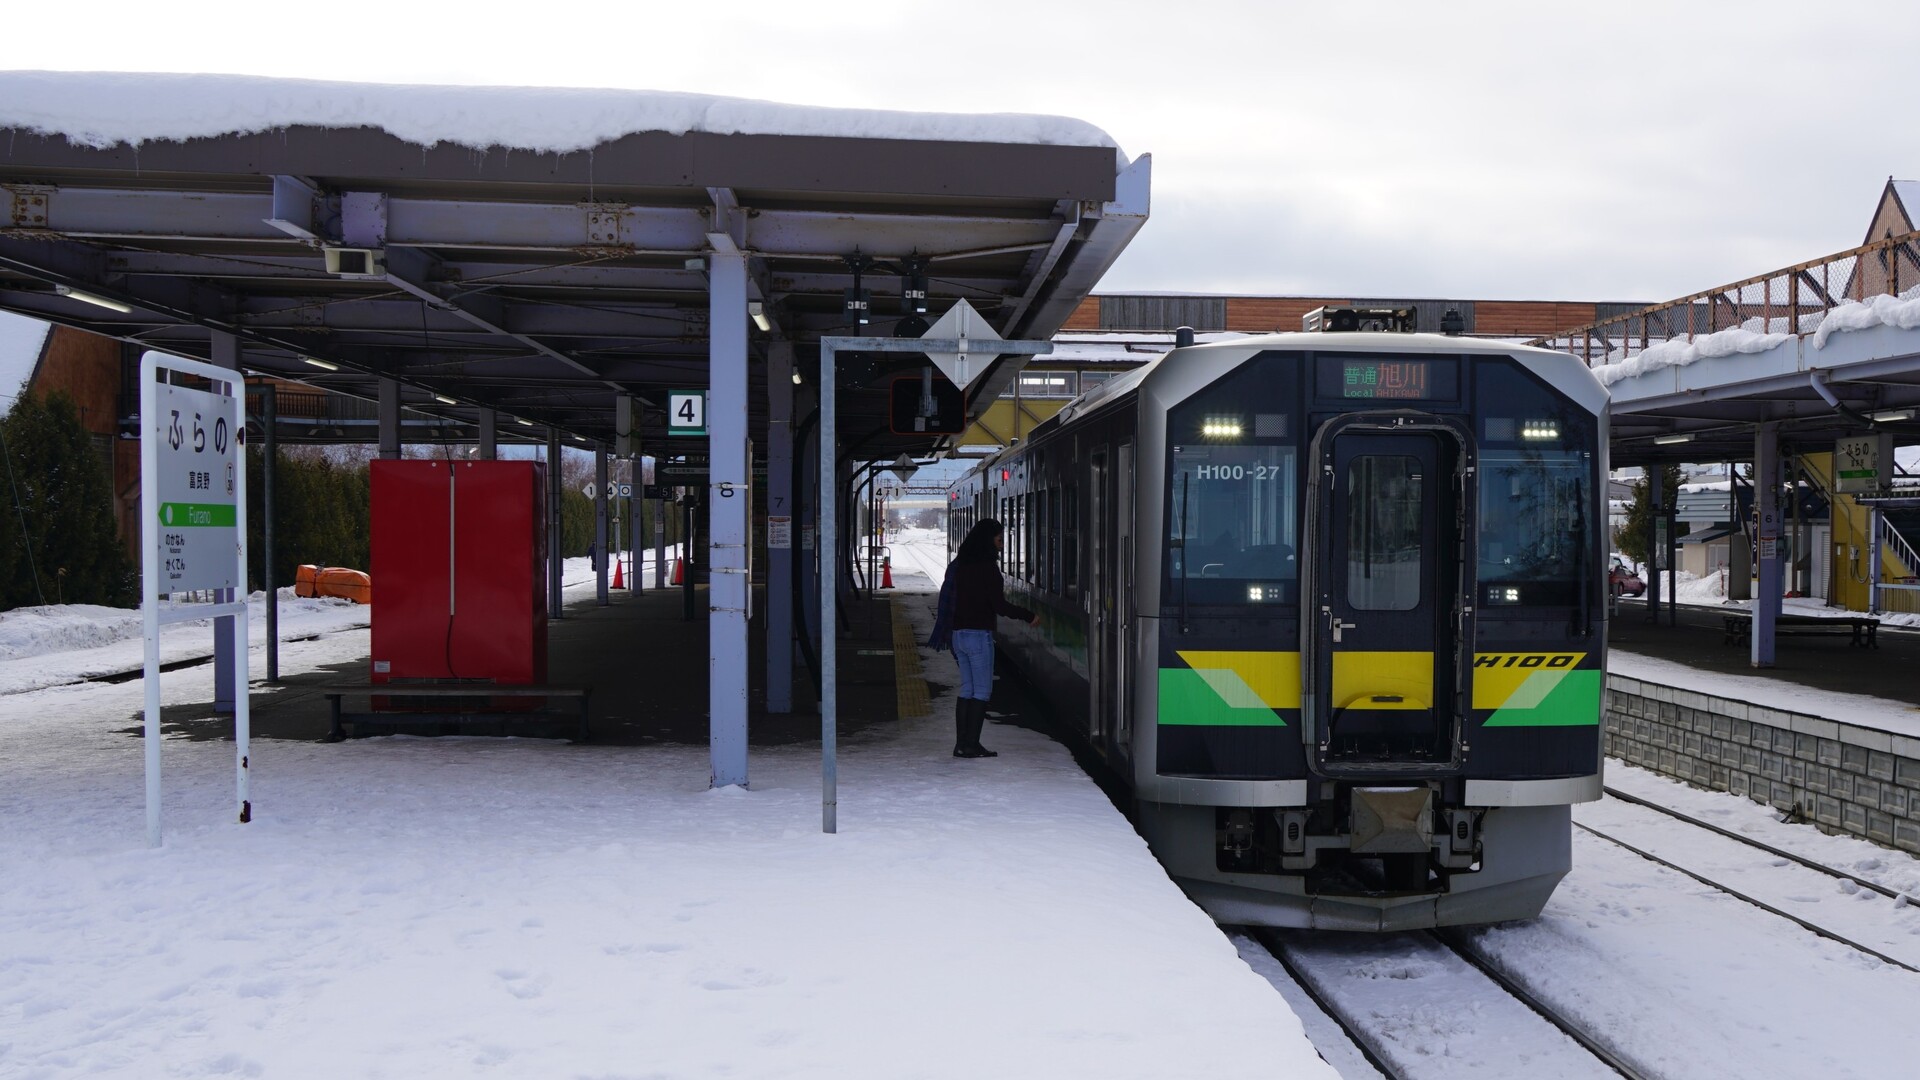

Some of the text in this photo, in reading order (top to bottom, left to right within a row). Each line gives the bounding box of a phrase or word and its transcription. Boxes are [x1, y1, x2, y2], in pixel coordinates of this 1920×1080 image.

[1344, 363, 1424, 389] 普通 旭川
[1344, 388, 1373, 397] Local
[678, 399, 695, 422] 4
[168, 409, 227, 455] ふらの
[1197, 465, 1280, 480] H100-27
[189, 471, 210, 489] 富良野
[589, 486, 593, 496] 1
[607, 486, 613, 495] 4
[662, 488, 668, 496] 5
[720, 481, 734, 498] 8
[876, 488, 882, 496] 4
[895, 488, 899, 496] 1
[774, 497, 784, 508] 7
[188, 506, 211, 524] Furano
[1765, 515, 1772, 523] 6
[165, 533, 185, 546] のかなん
[1474, 655, 1575, 668] H100
